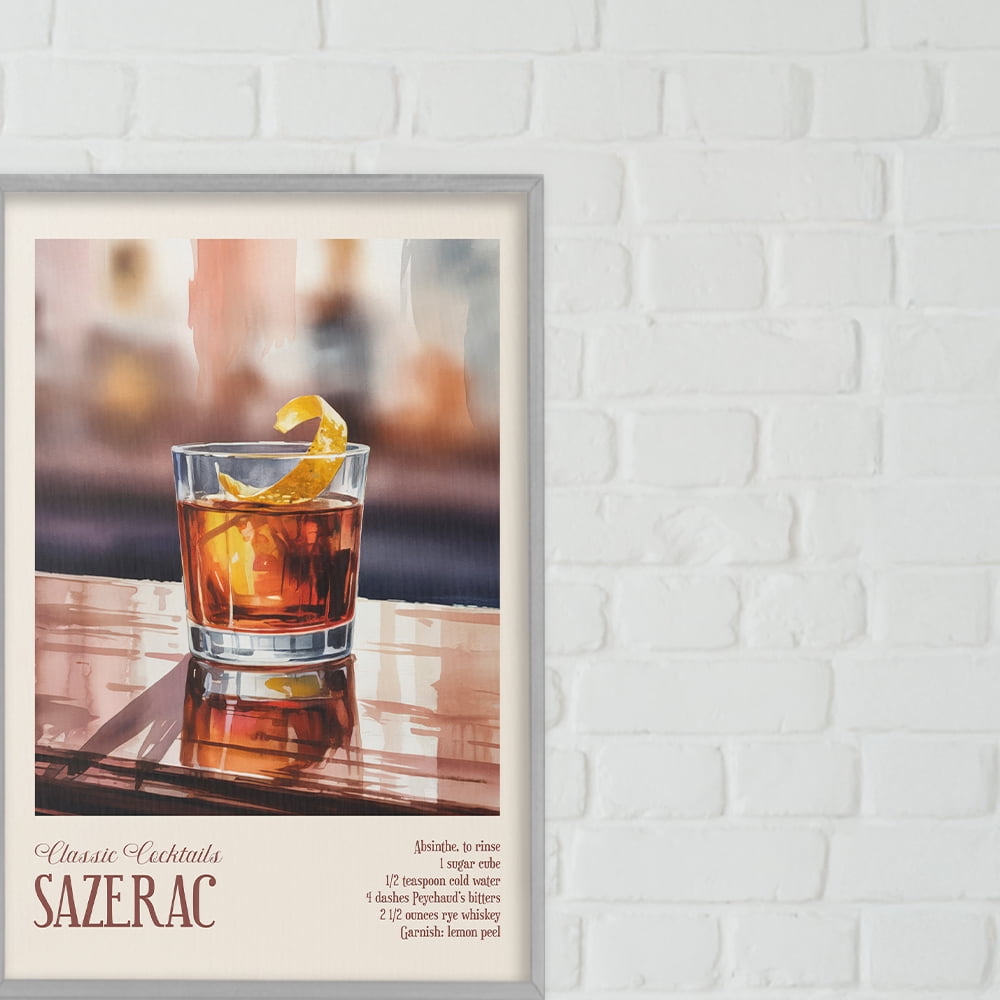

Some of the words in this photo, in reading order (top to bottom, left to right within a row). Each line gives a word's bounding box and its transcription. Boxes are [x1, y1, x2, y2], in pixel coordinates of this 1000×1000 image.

[34, 840, 119, 865] Classic
[123, 840, 223, 865] Cocktails
[462, 841, 472, 853] to
[475, 840, 501, 852] rinse
[440, 857, 444, 869] 1
[447, 859, 476, 872] sugar
[479, 857, 501, 869] cube
[386, 874, 399, 888] 1/2
[402, 875, 446, 889] teaspoon
[449, 874, 469, 886] cold
[472, 875, 501, 887] water
[34, 873, 217, 928] SAZERAC
[366, 891, 372, 904] 4
[375, 891, 410, 904] dashes
[412, 891, 466, 906] Peychaud's
[468, 891, 501, 904] bitters
[380, 908, 386, 920] 2
[389, 908, 402, 923] 1/2
[405, 912, 439, 921] ounces
[442, 912, 459, 923] rye
[461, 908, 501, 923] whiskey
[400, 925, 444, 940] Garnish:
[448, 925, 478, 937] lemon
[481, 925, 501, 940] peel
